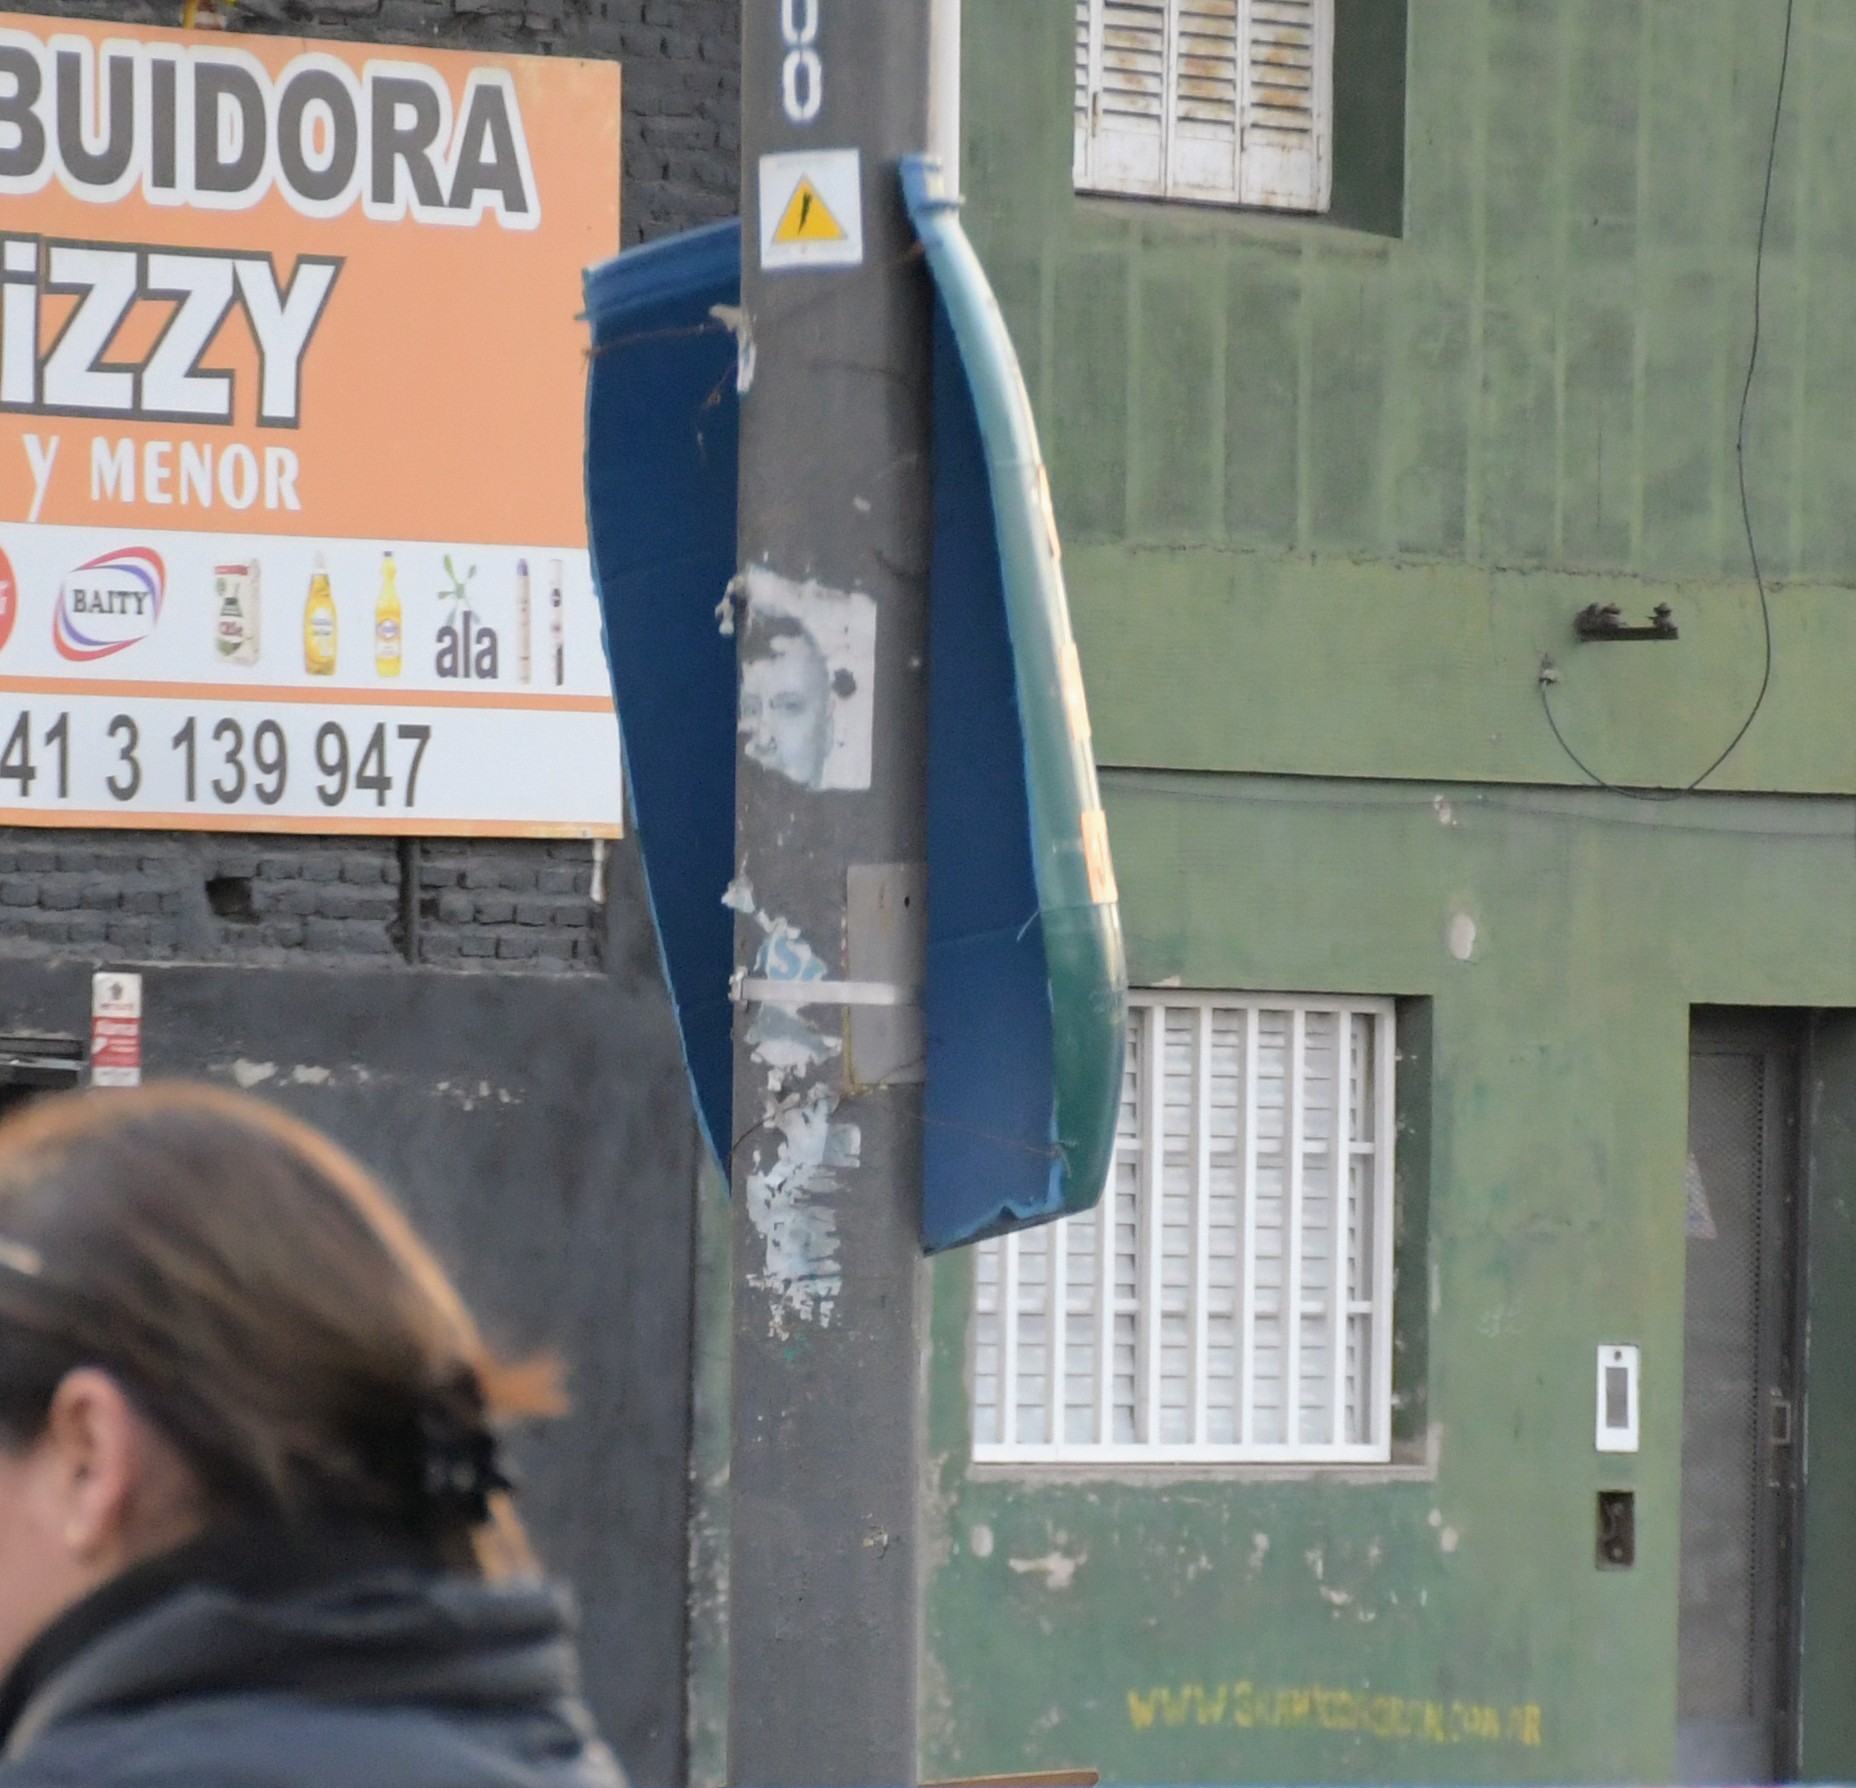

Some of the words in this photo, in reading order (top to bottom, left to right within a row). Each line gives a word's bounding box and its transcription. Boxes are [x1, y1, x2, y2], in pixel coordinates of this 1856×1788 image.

[89, 435, 303, 513] MENOR
[73, 588, 150, 616] BAITY
[434, 608, 500, 680] ala
[105, 713, 142, 803] 3
[170, 715, 288, 806] 139
[314, 720, 433, 809] 947
